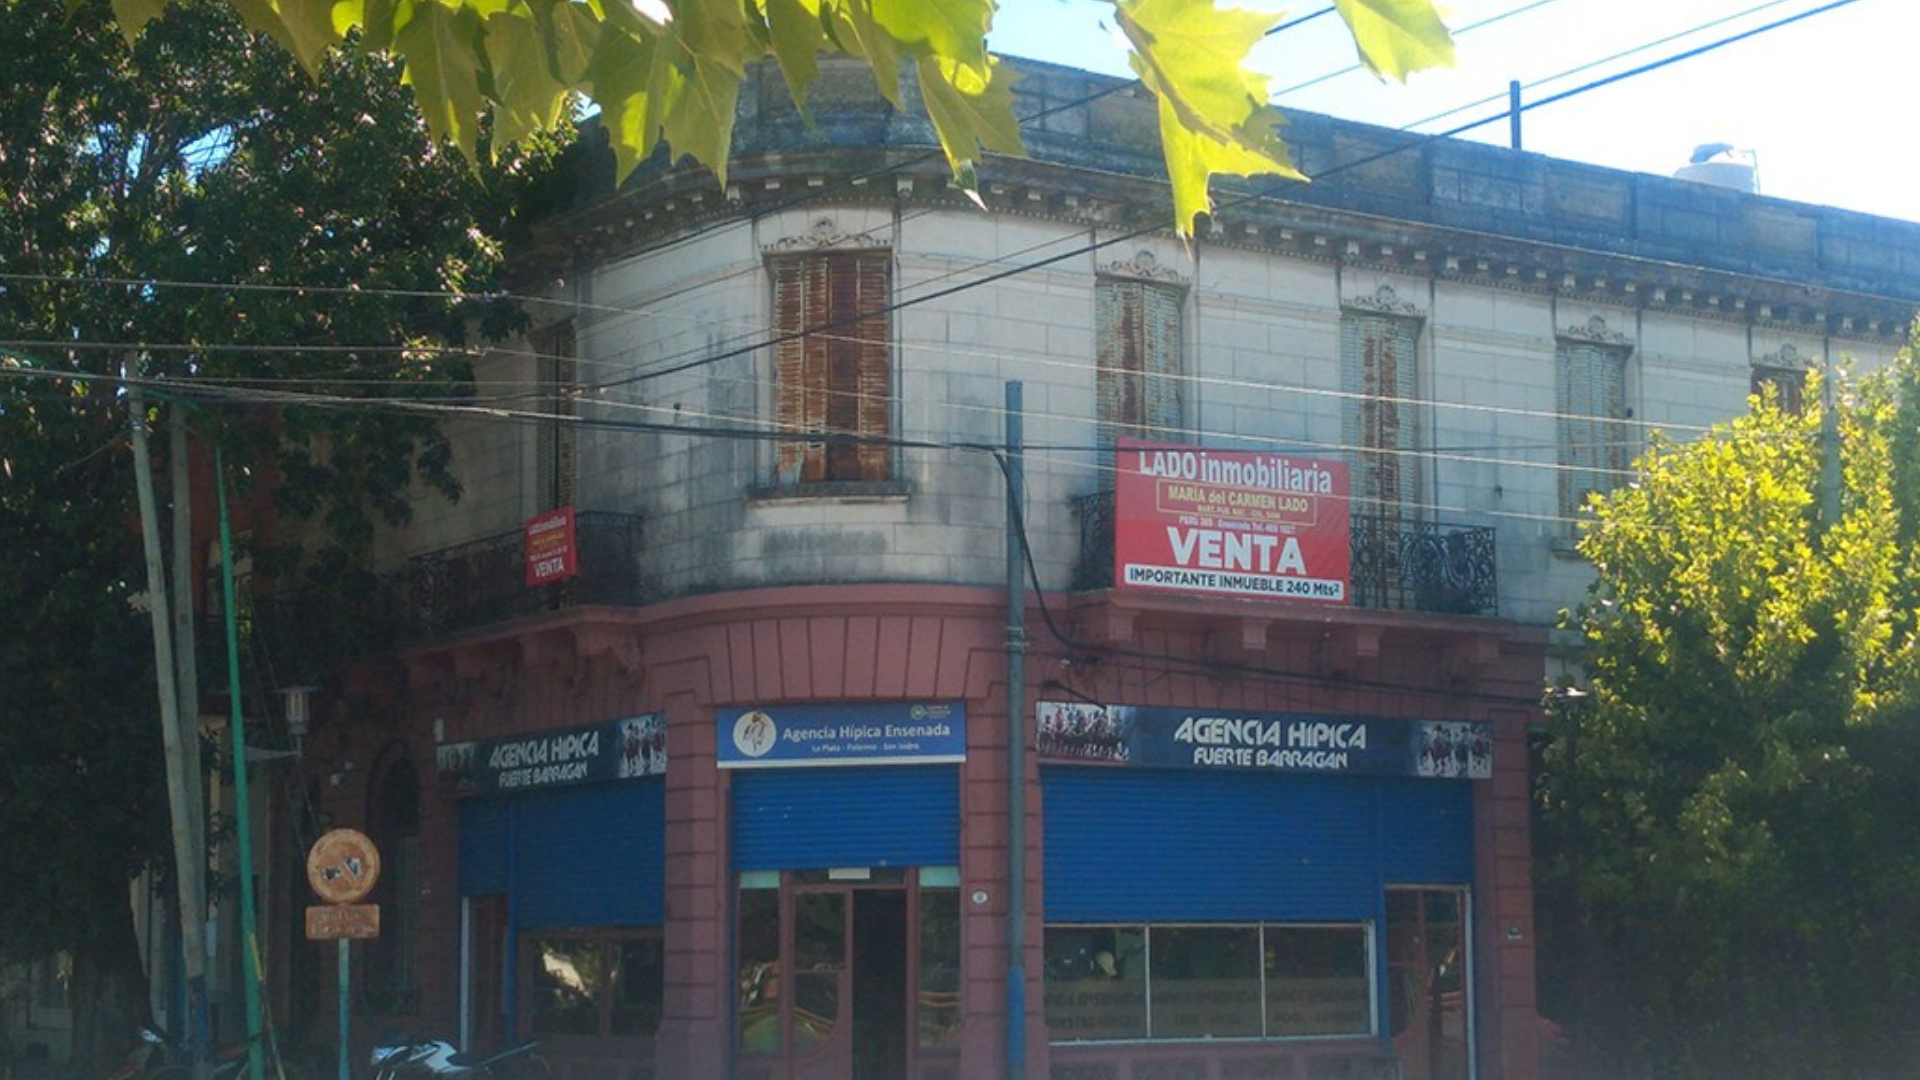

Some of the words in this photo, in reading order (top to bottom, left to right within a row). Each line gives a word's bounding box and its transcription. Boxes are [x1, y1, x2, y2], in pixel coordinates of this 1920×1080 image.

[1138, 451, 1198, 478] LADO
[1201, 452, 1332, 494] inmobiliaria
[1208, 490, 1226, 505] del
[1228, 492, 1275, 510] CARMEN
[1278, 497, 1308, 513] LADO
[1167, 526, 1307, 574] VENTA
[534, 558, 564, 577] VENTA
[1130, 567, 1216, 588] IMPORTANTE
[1219, 577, 1283, 593] INMUEBLE
[1286, 582, 1310, 595] 240
[783, 726, 836, 743] Agencia
[885, 723, 950, 737] Ensenada
[1175, 717, 1280, 744] AGENCIA
[1288, 723, 1366, 749] HIPICA
[490, 739, 548, 768] AGENCIA
[551, 730, 600, 761] HIPICA
[1194, 748, 1252, 766] FUERTE
[1256, 751, 1347, 769] BARRAGAN
[533, 761, 589, 783] BARRAGAN
